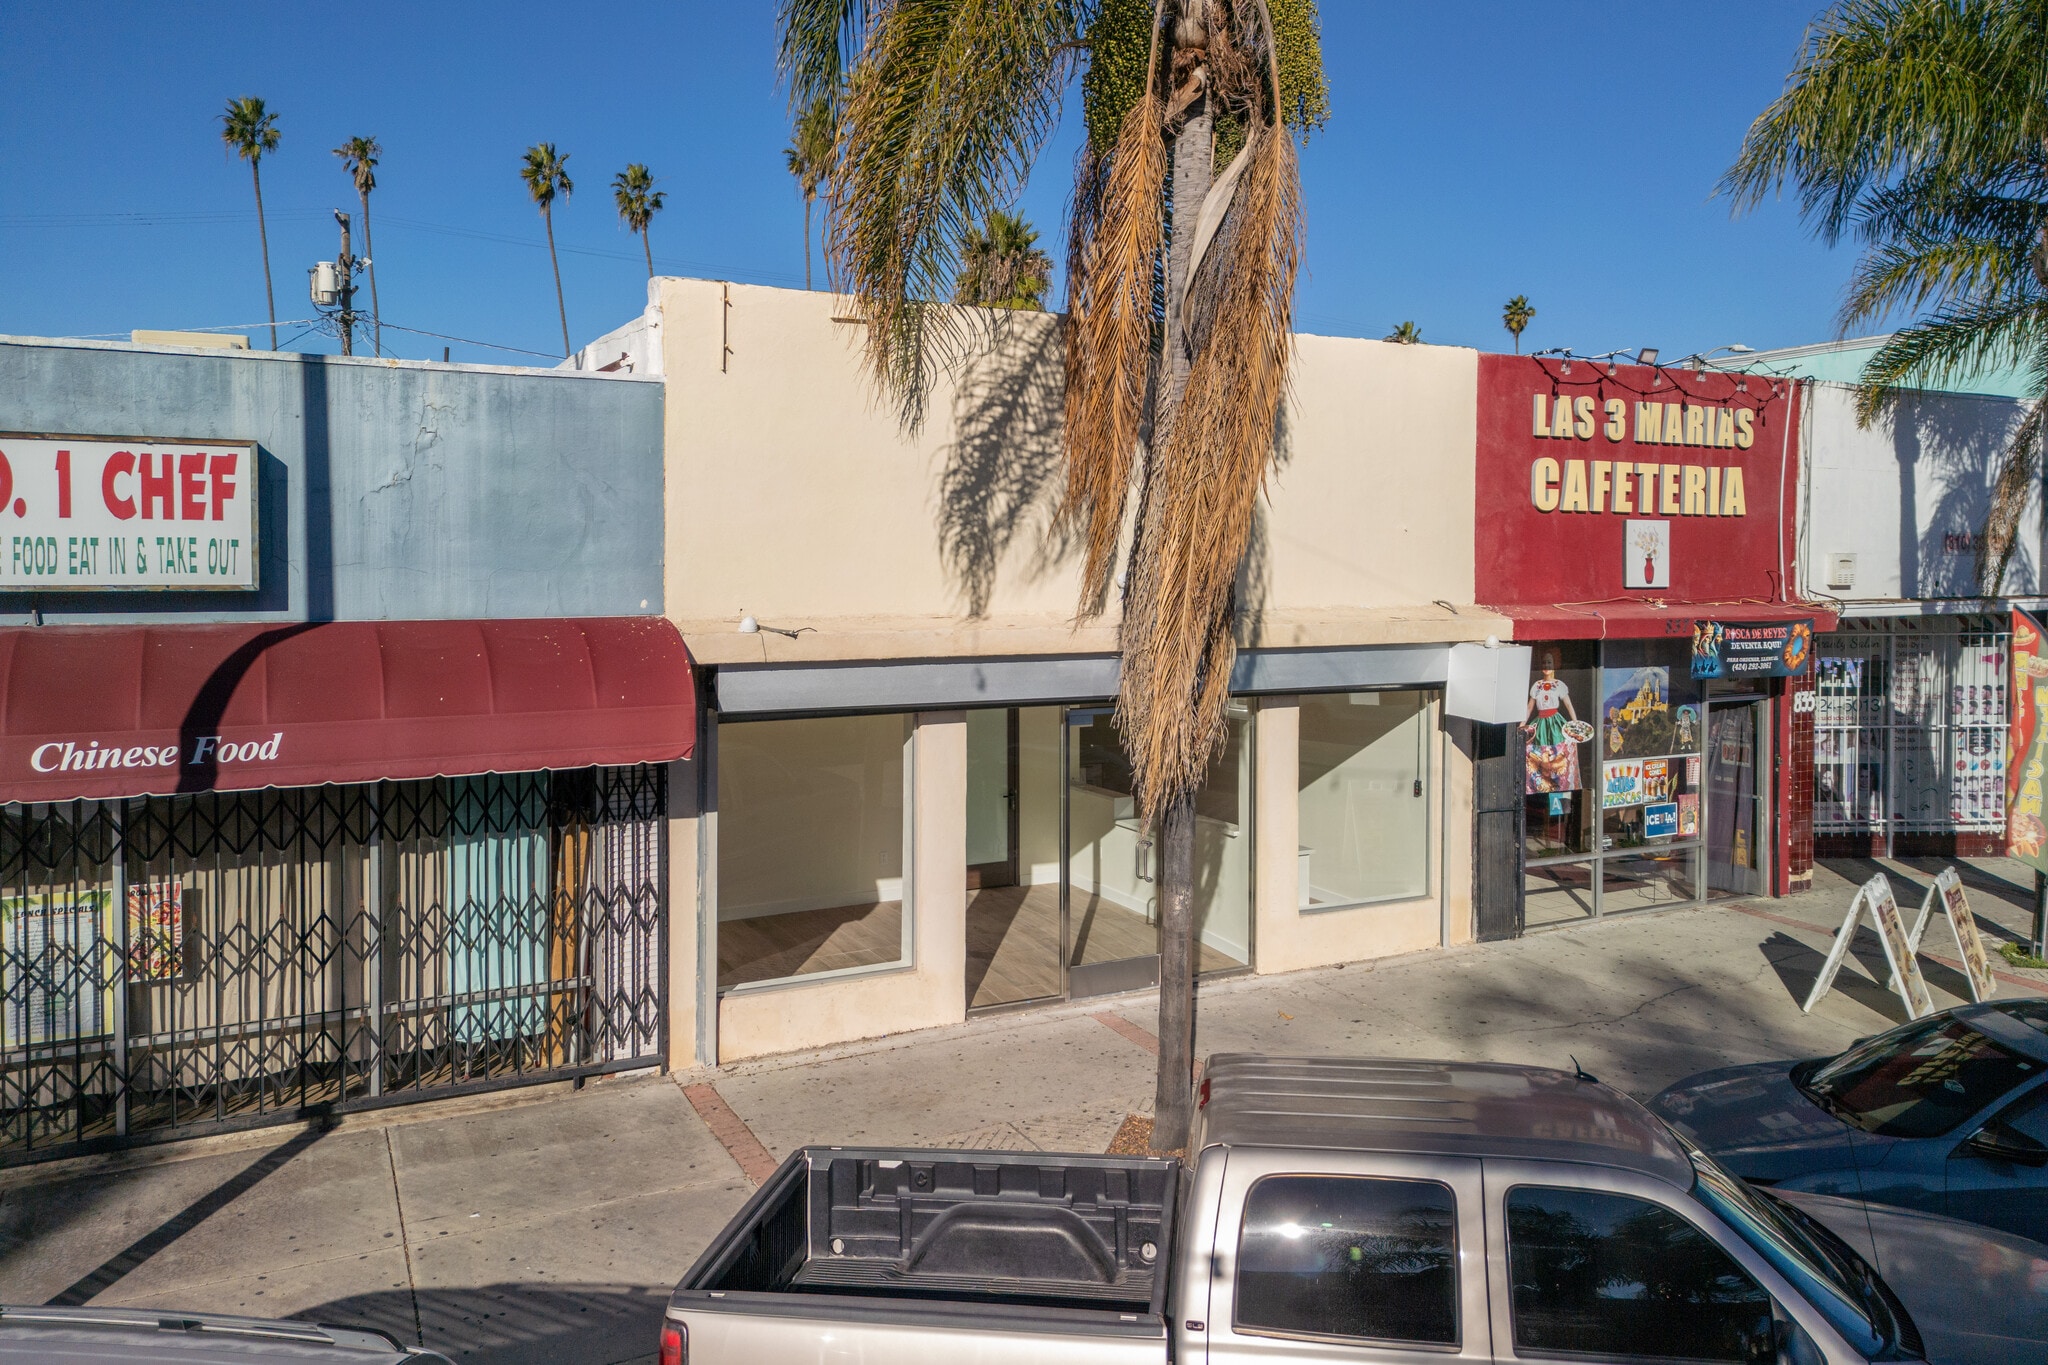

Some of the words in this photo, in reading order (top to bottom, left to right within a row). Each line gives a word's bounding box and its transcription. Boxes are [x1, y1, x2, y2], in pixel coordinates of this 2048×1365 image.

[1533, 394, 1596, 440] LAS
[1604, 398, 1626, 443] 3
[1634, 401, 1755, 449] MARIAS
[55, 450, 71, 518] 1
[101, 450, 238, 520] CHEF
[1531, 457, 1746, 516] CAFETERIA
[13, 536, 58, 575] FOOD
[69, 537, 99, 575] EAT
[109, 537, 126, 575] IN
[137, 537, 147, 575] &
[156, 537, 198, 574] TAKE
[208, 538, 239, 576] OUT
[1763, 627, 1787, 639] REYES
[1794, 691, 1817, 713] 835
[30, 740, 179, 773] Chinese
[187, 732, 283, 766] Food
[1552, 796, 1561, 810] A
[1603, 792, 1642, 807] FRESCAS
[1646, 813, 1660, 826] ICE
[52, 905, 95, 916] SPECALS
